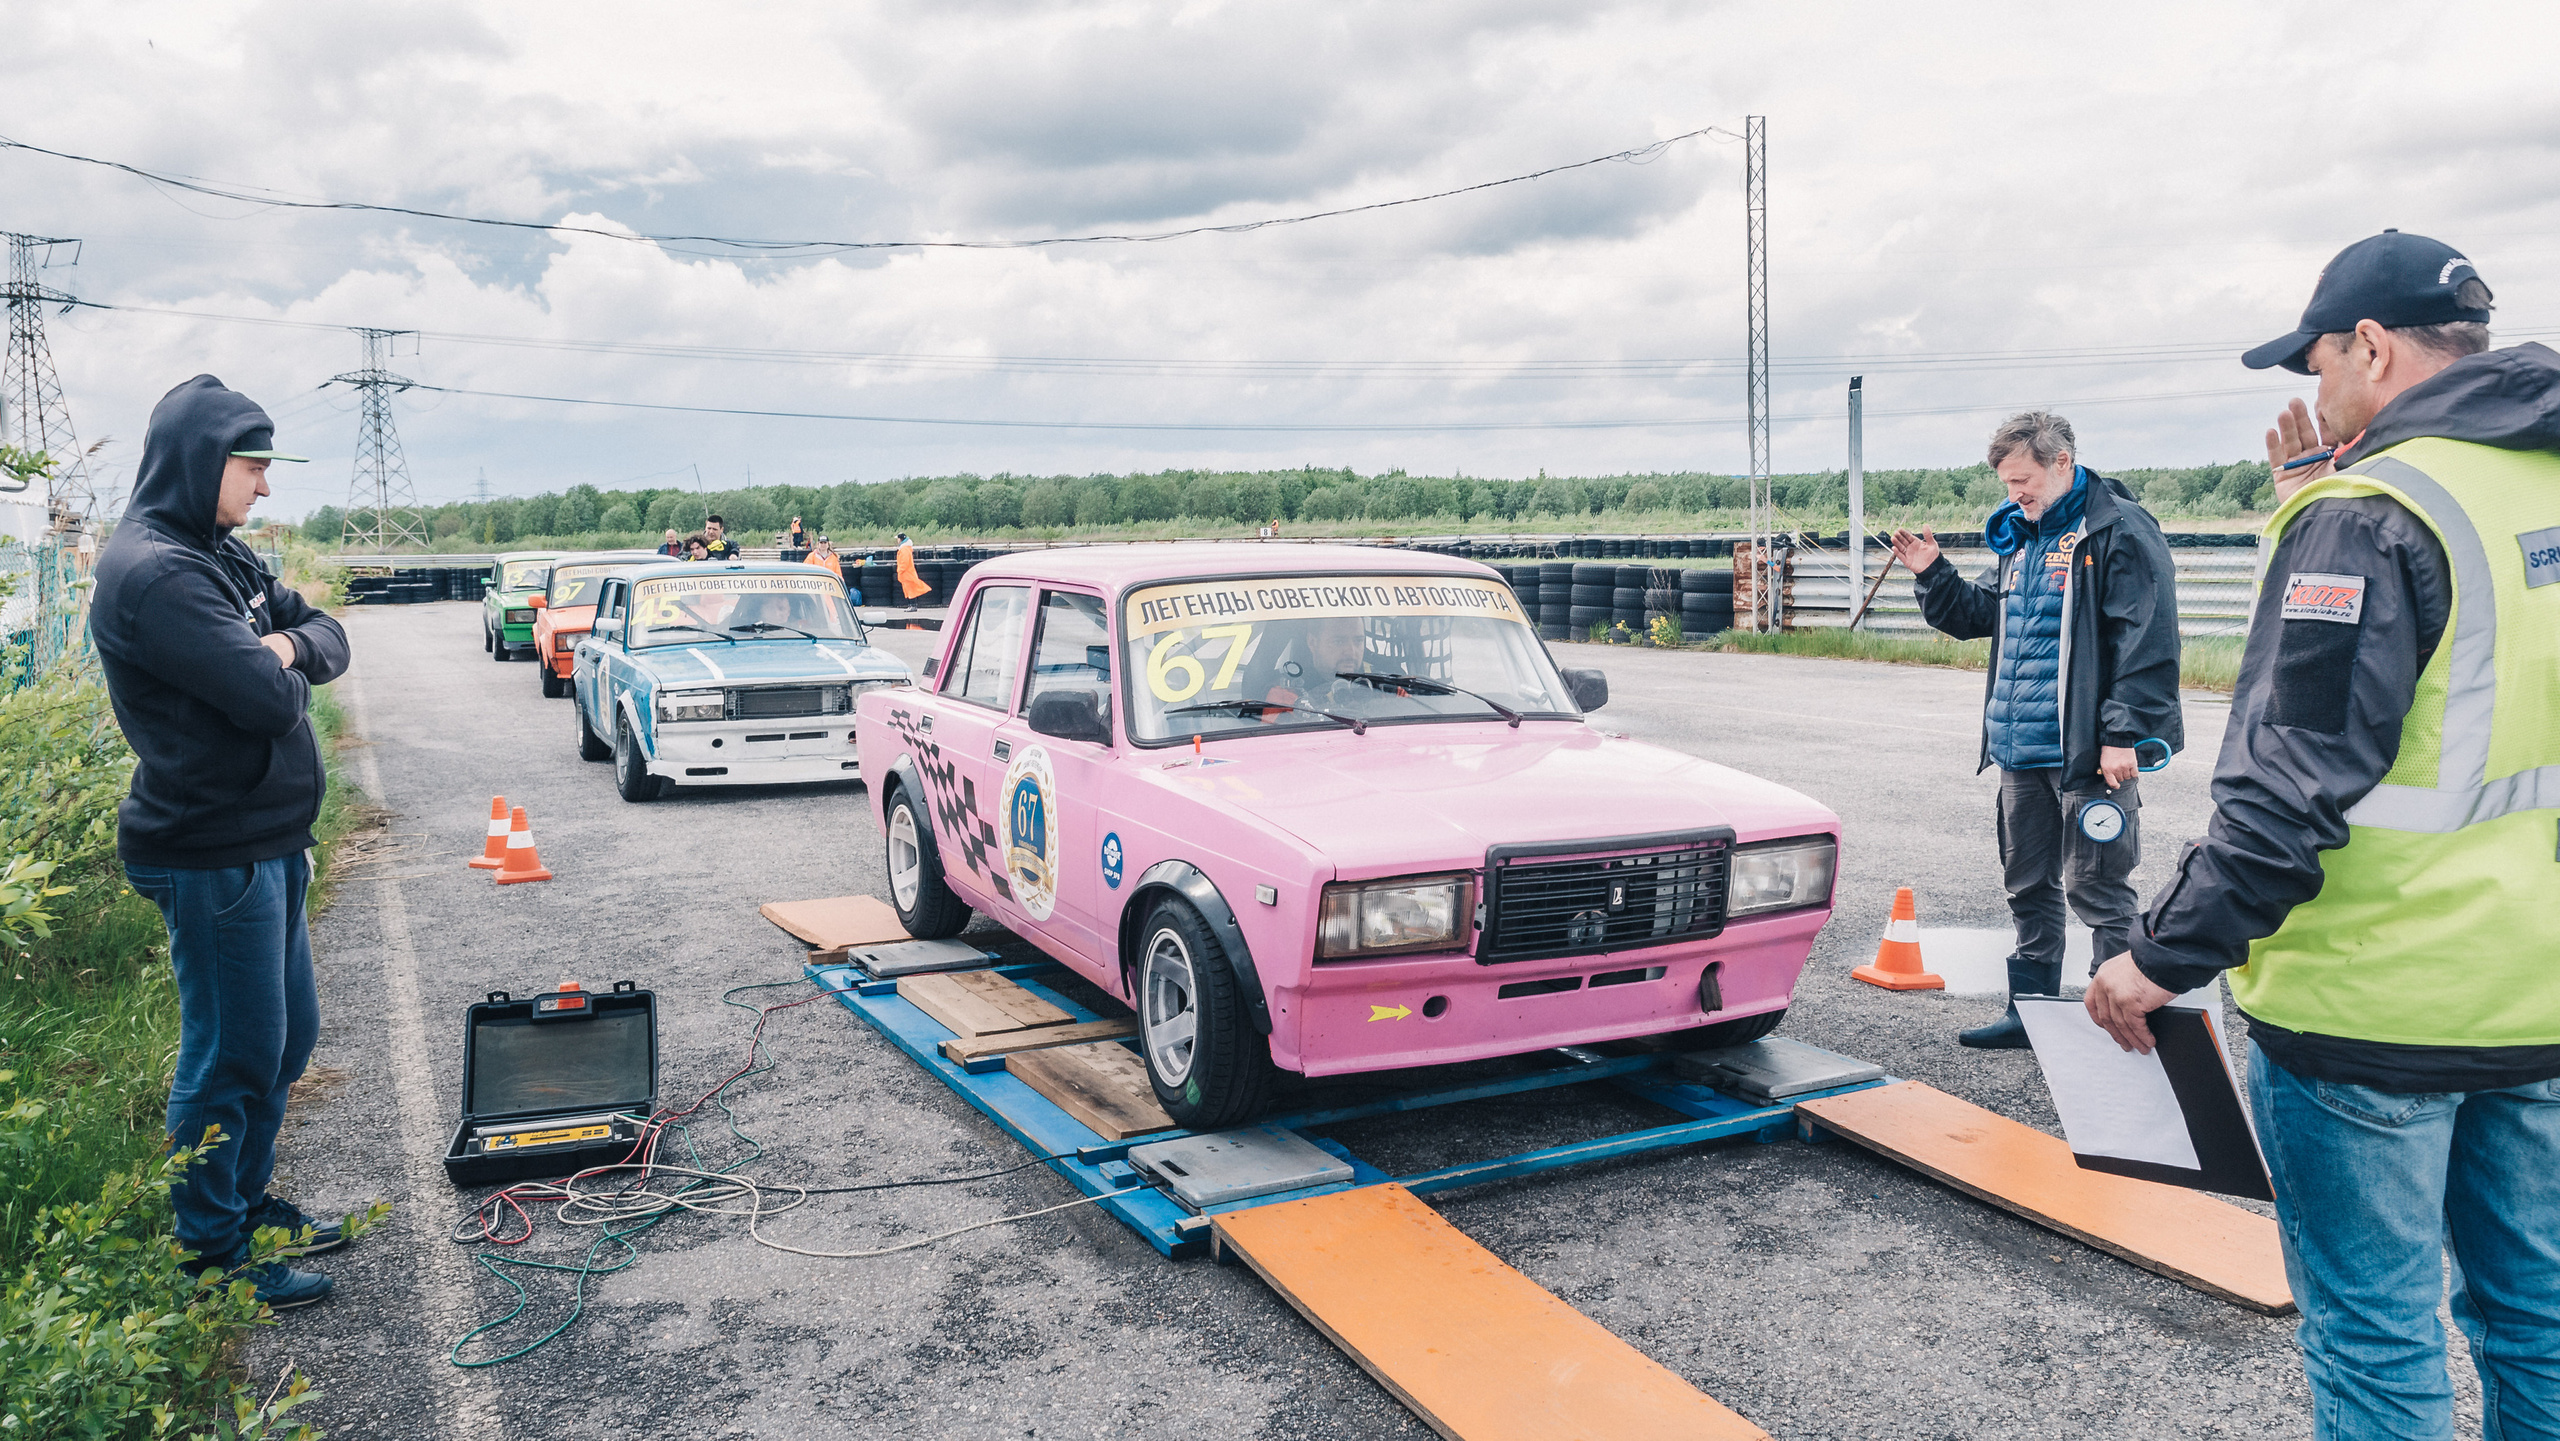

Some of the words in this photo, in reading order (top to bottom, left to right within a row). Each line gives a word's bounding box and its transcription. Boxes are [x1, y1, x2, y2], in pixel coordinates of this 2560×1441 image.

[553, 581, 586, 606] 97
[642, 580, 697, 597] ЛЕГЕНДЫ
[699, 579, 768, 591] СОВЕТСКОГО
[770, 579, 836, 593] АВТОСПОРТА
[2286, 584, 2361, 610] KLOTZ
[630, 595, 682, 628] 45
[1140, 589, 1256, 626] ЛЕГЕНДЫ
[1257, 585, 1392, 611] СОВЕТСКОГО
[1394, 585, 1514, 614] АВТОСПОРТА
[1146, 624, 1253, 703] 67
[1017, 789, 1039, 842] 67
